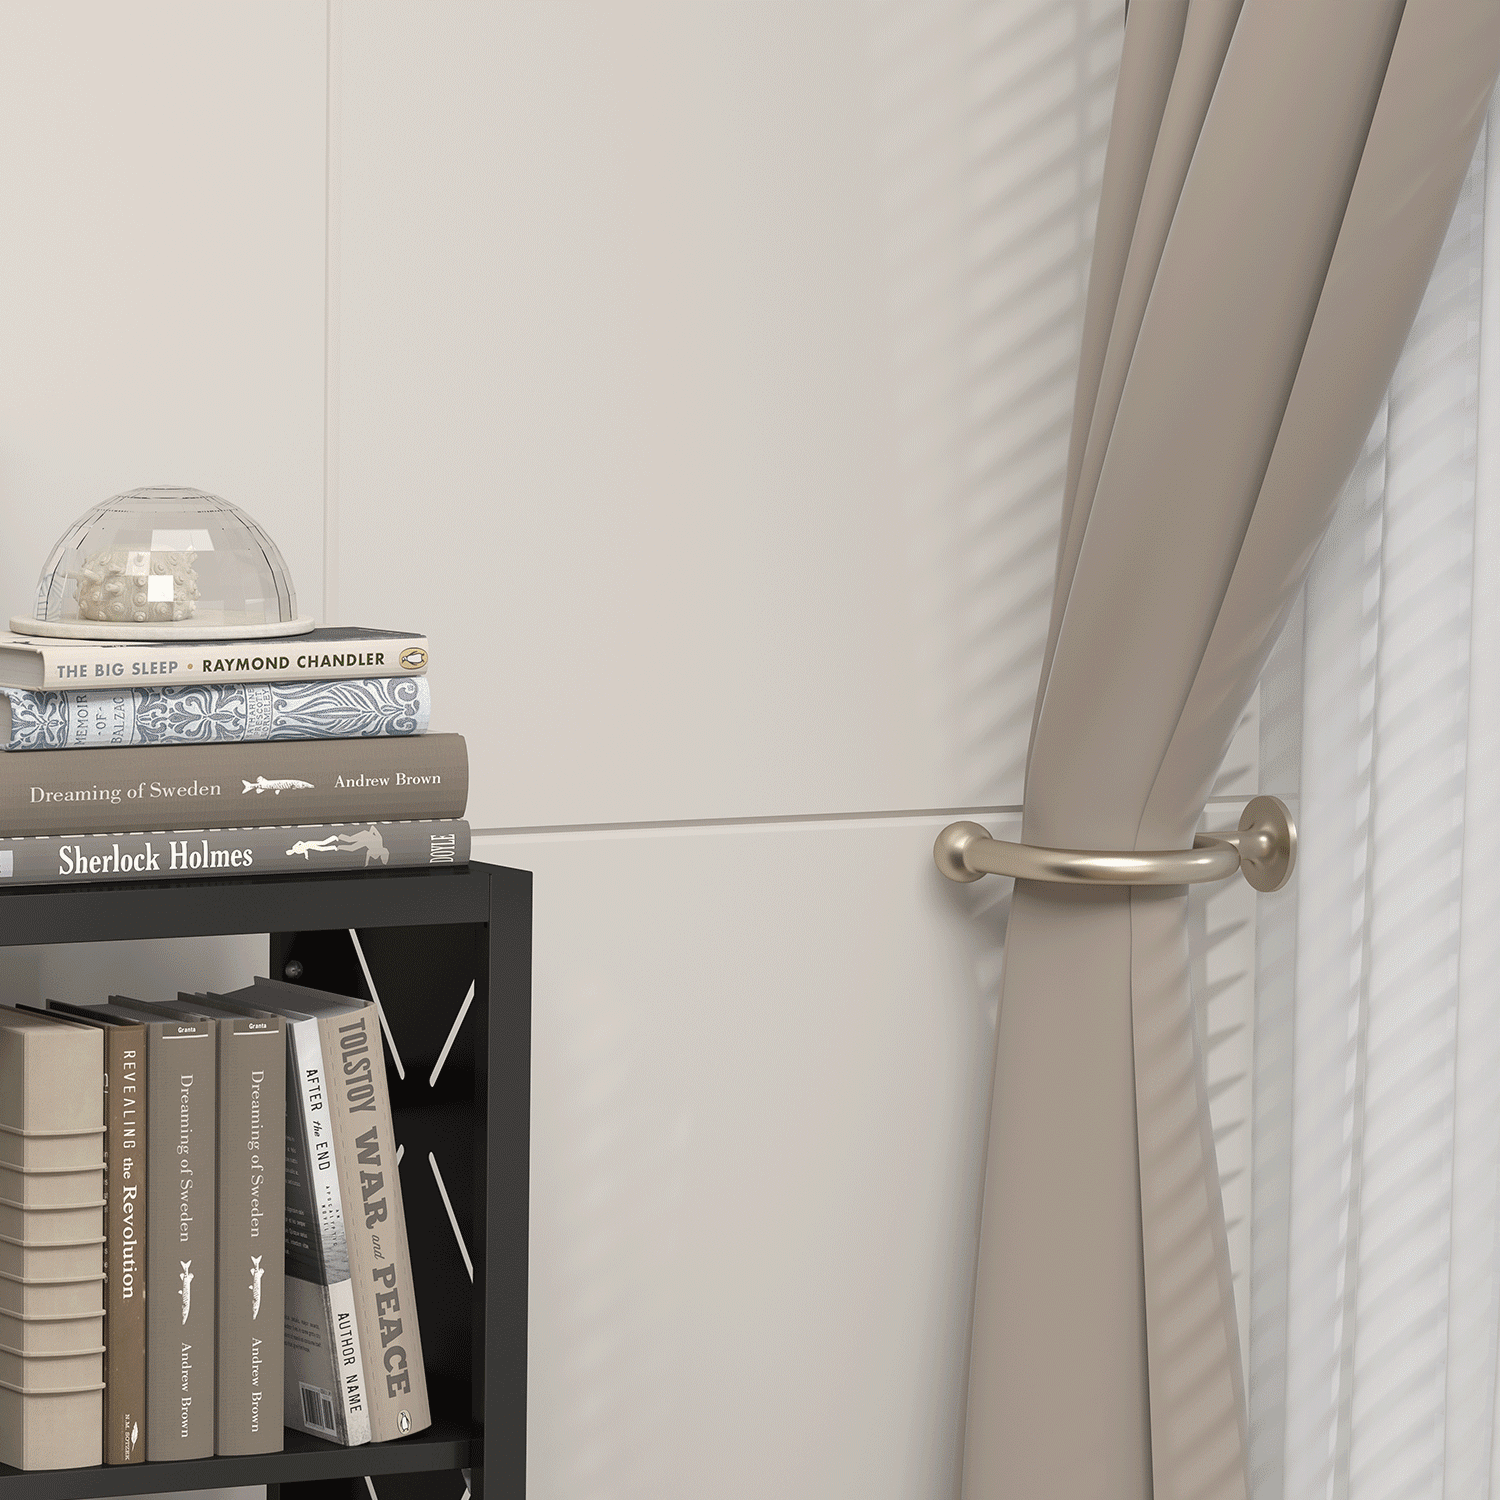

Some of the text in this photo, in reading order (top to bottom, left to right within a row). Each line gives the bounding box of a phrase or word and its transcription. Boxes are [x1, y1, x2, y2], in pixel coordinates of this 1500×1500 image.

[57, 652, 385, 679] THE BIG SLEEP RAYMOND CHANDLER
[74, 694, 88, 745] MEMOIR
[111, 697, 125, 743] BALZAC
[30, 780, 221, 804] Dreaming of Sweden
[334, 772, 441, 788] Andrew Brown
[59, 840, 253, 875] Sherlock Holmes
[429, 833, 455, 863] DOYLE
[248, 1022, 267, 1030] Granta
[247, 1070, 265, 1238] Dreaming of Sweden
[306, 1069, 331, 1171] AFTER the END
[122, 1050, 138, 1300] REVEALING the Revolution
[176, 1074, 193, 1242] Dreaming of Sweden
[338, 1017, 411, 1399] TOLSTOY WAR and PEACE
[181, 1342, 192, 1438] Andrew Brown
[251, 1337, 263, 1433] Andrew Brown
[337, 1313, 362, 1414] AUTHOR NAME
